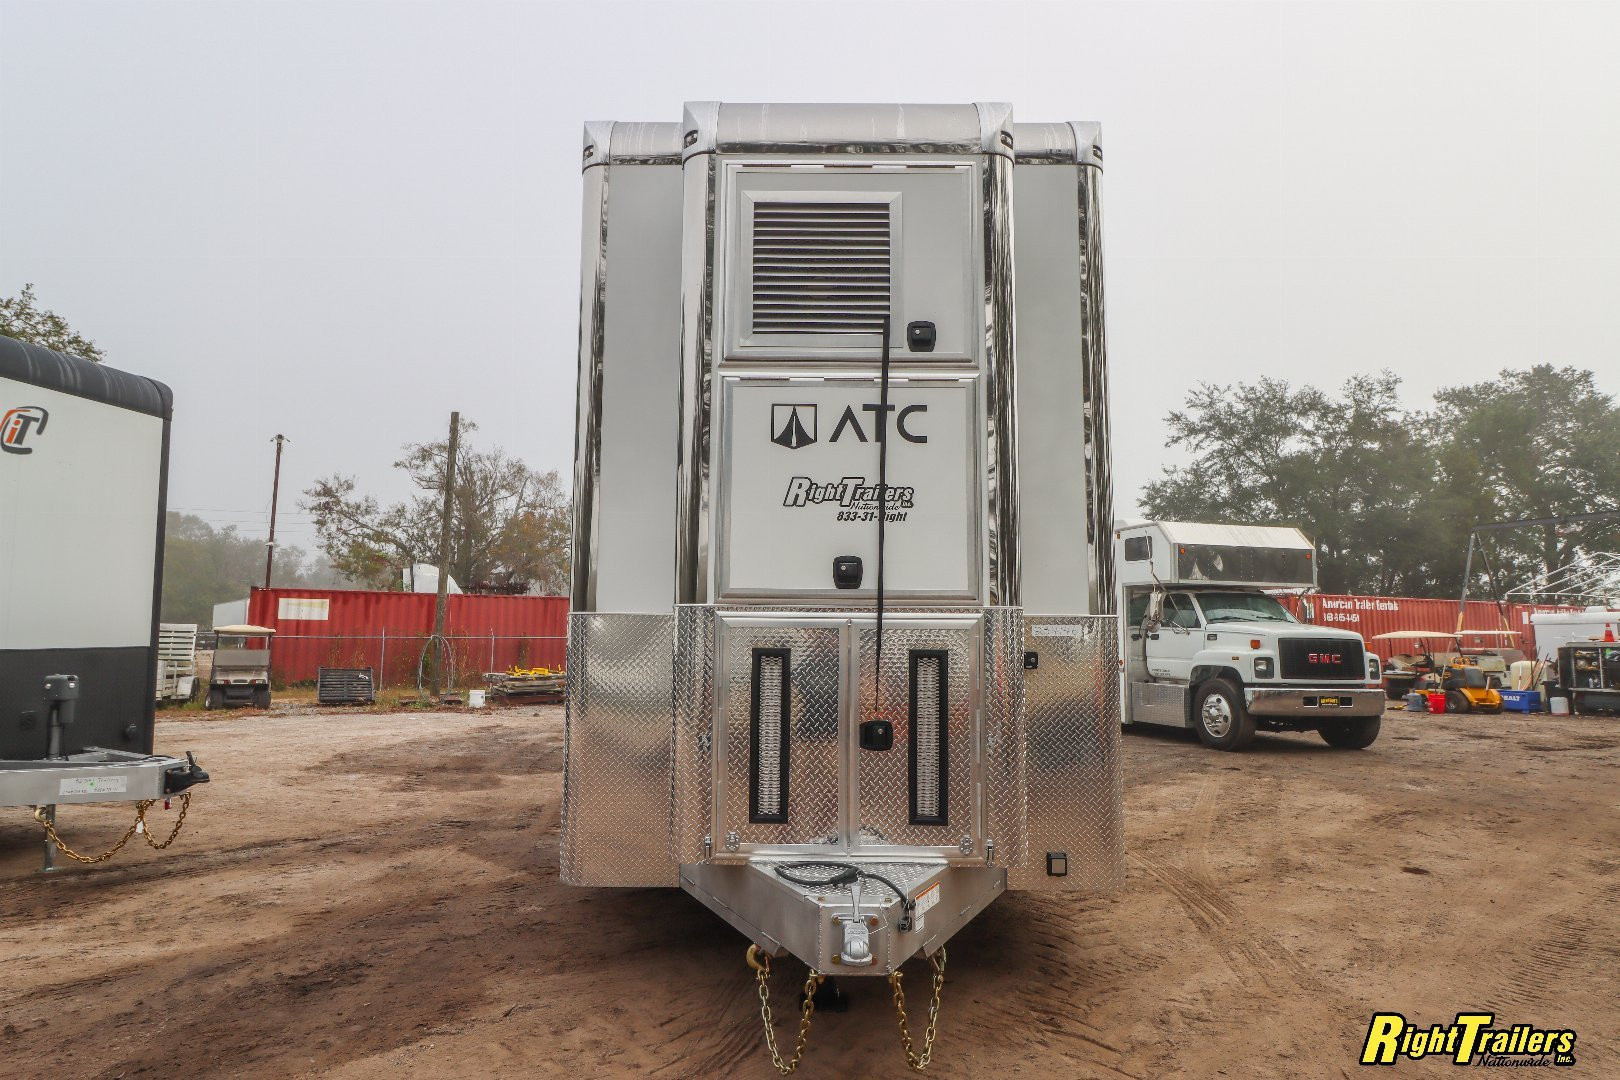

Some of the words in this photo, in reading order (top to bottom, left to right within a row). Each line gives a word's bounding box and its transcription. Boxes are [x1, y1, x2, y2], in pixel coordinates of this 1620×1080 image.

[828, 403, 928, 443] ATC
[783, 476, 915, 508] RightTraiers
[849, 501, 901, 511] Nationide
[836, 511, 908, 522] 833-31-ight
[1308, 653, 1341, 663] GMC
